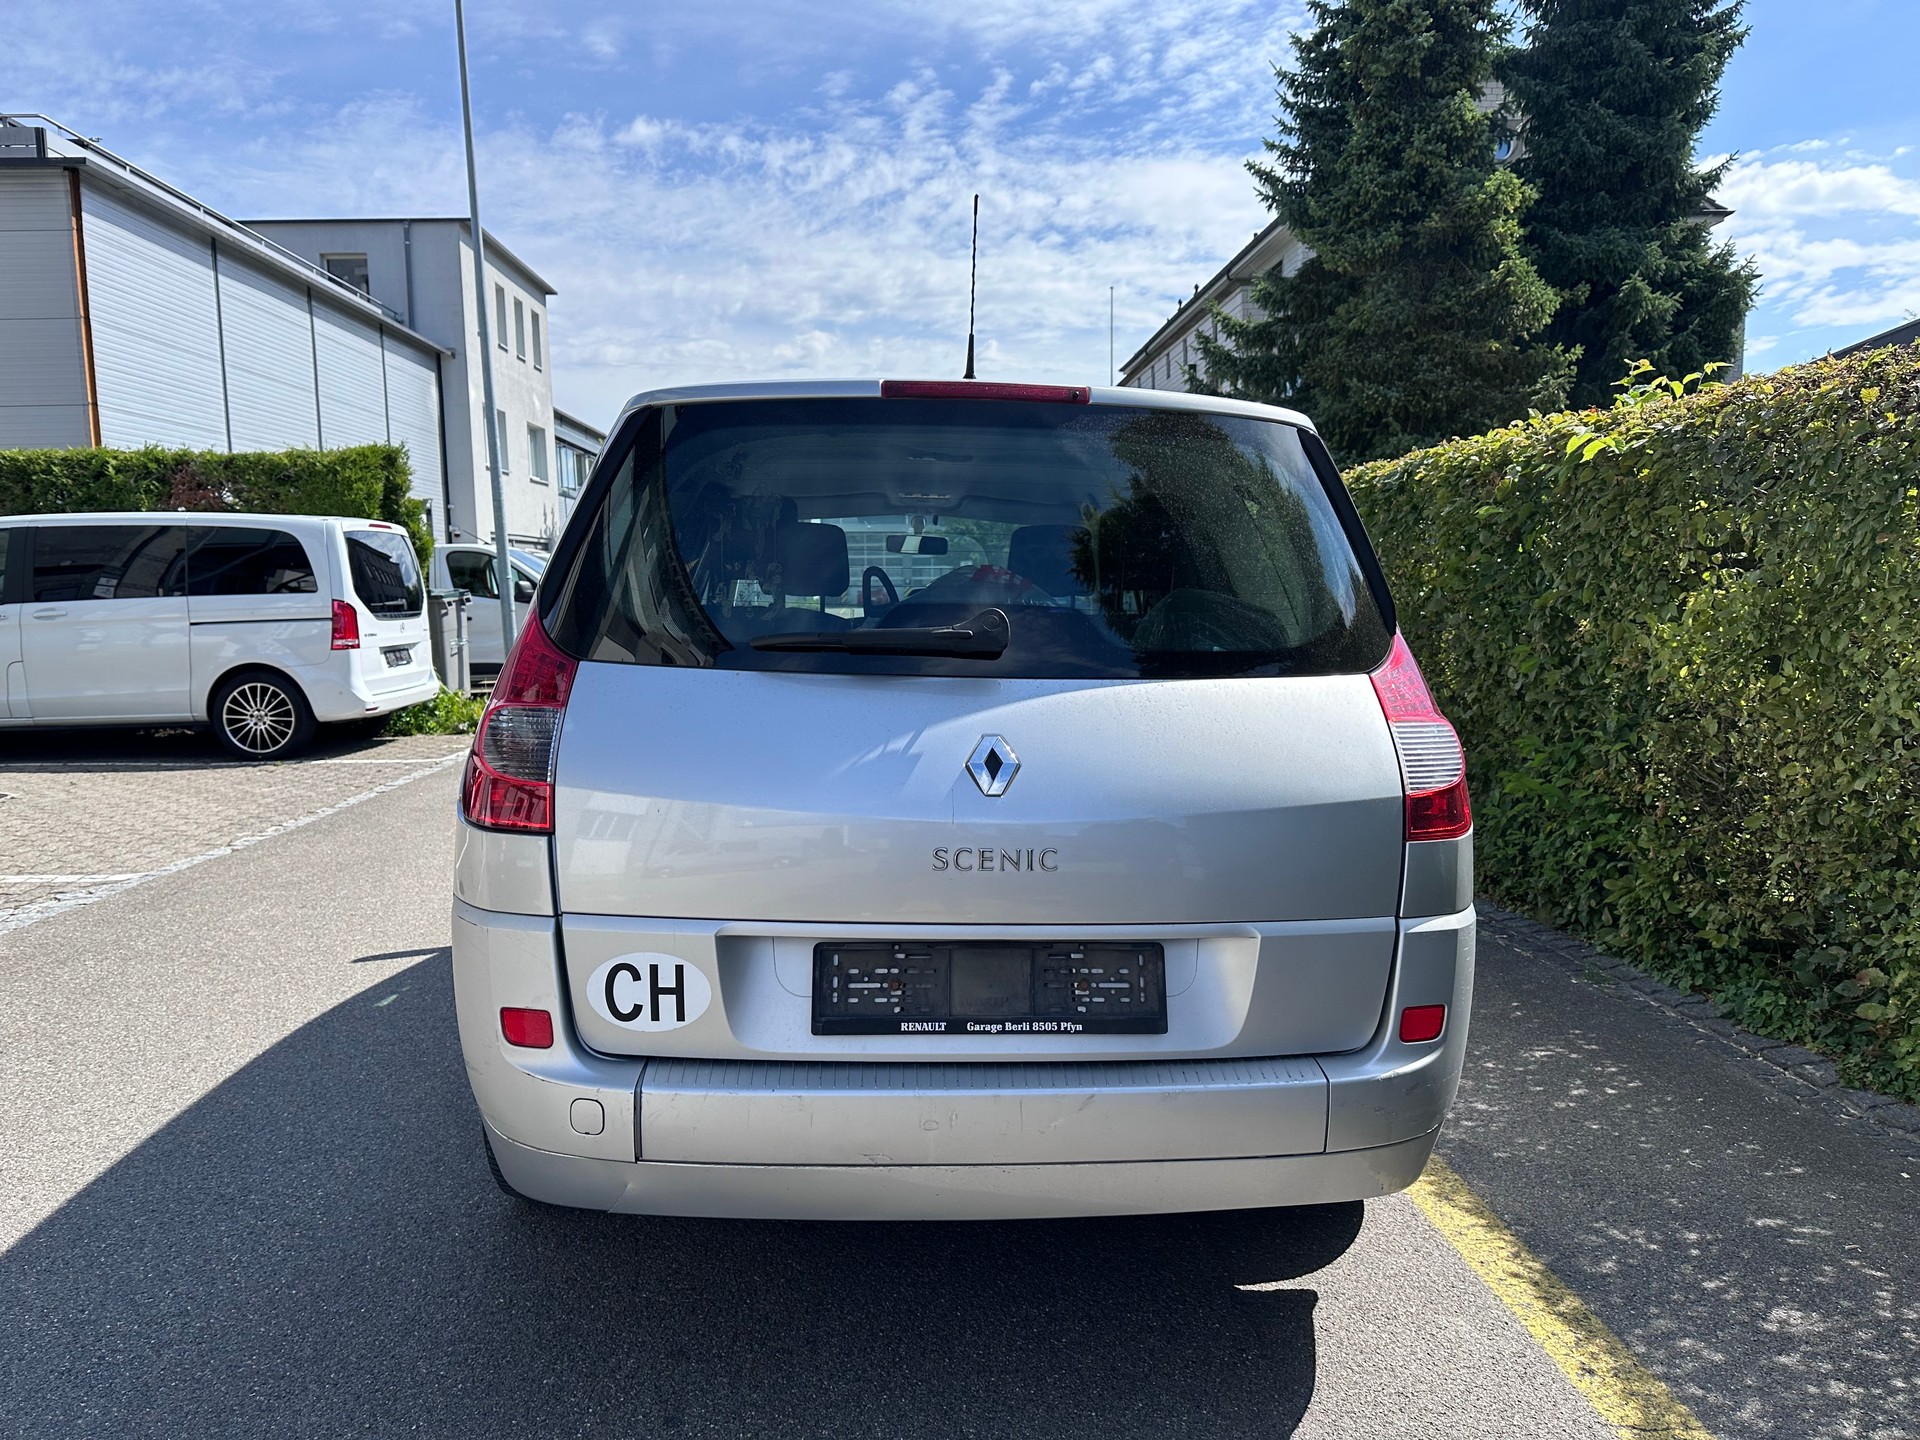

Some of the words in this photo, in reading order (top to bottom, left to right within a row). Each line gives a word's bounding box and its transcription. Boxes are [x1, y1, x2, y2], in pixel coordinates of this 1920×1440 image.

[932, 847, 1059, 872] SCENIC
[604, 962, 686, 1023] CH
[900, 1022, 947, 1032] RENAULT
[966, 1021, 1003, 1034] Garage
[1004, 1021, 1031, 1032] Berli
[1032, 1021, 1058, 1032] 8505
[1060, 1021, 1083, 1034] Pfyn
